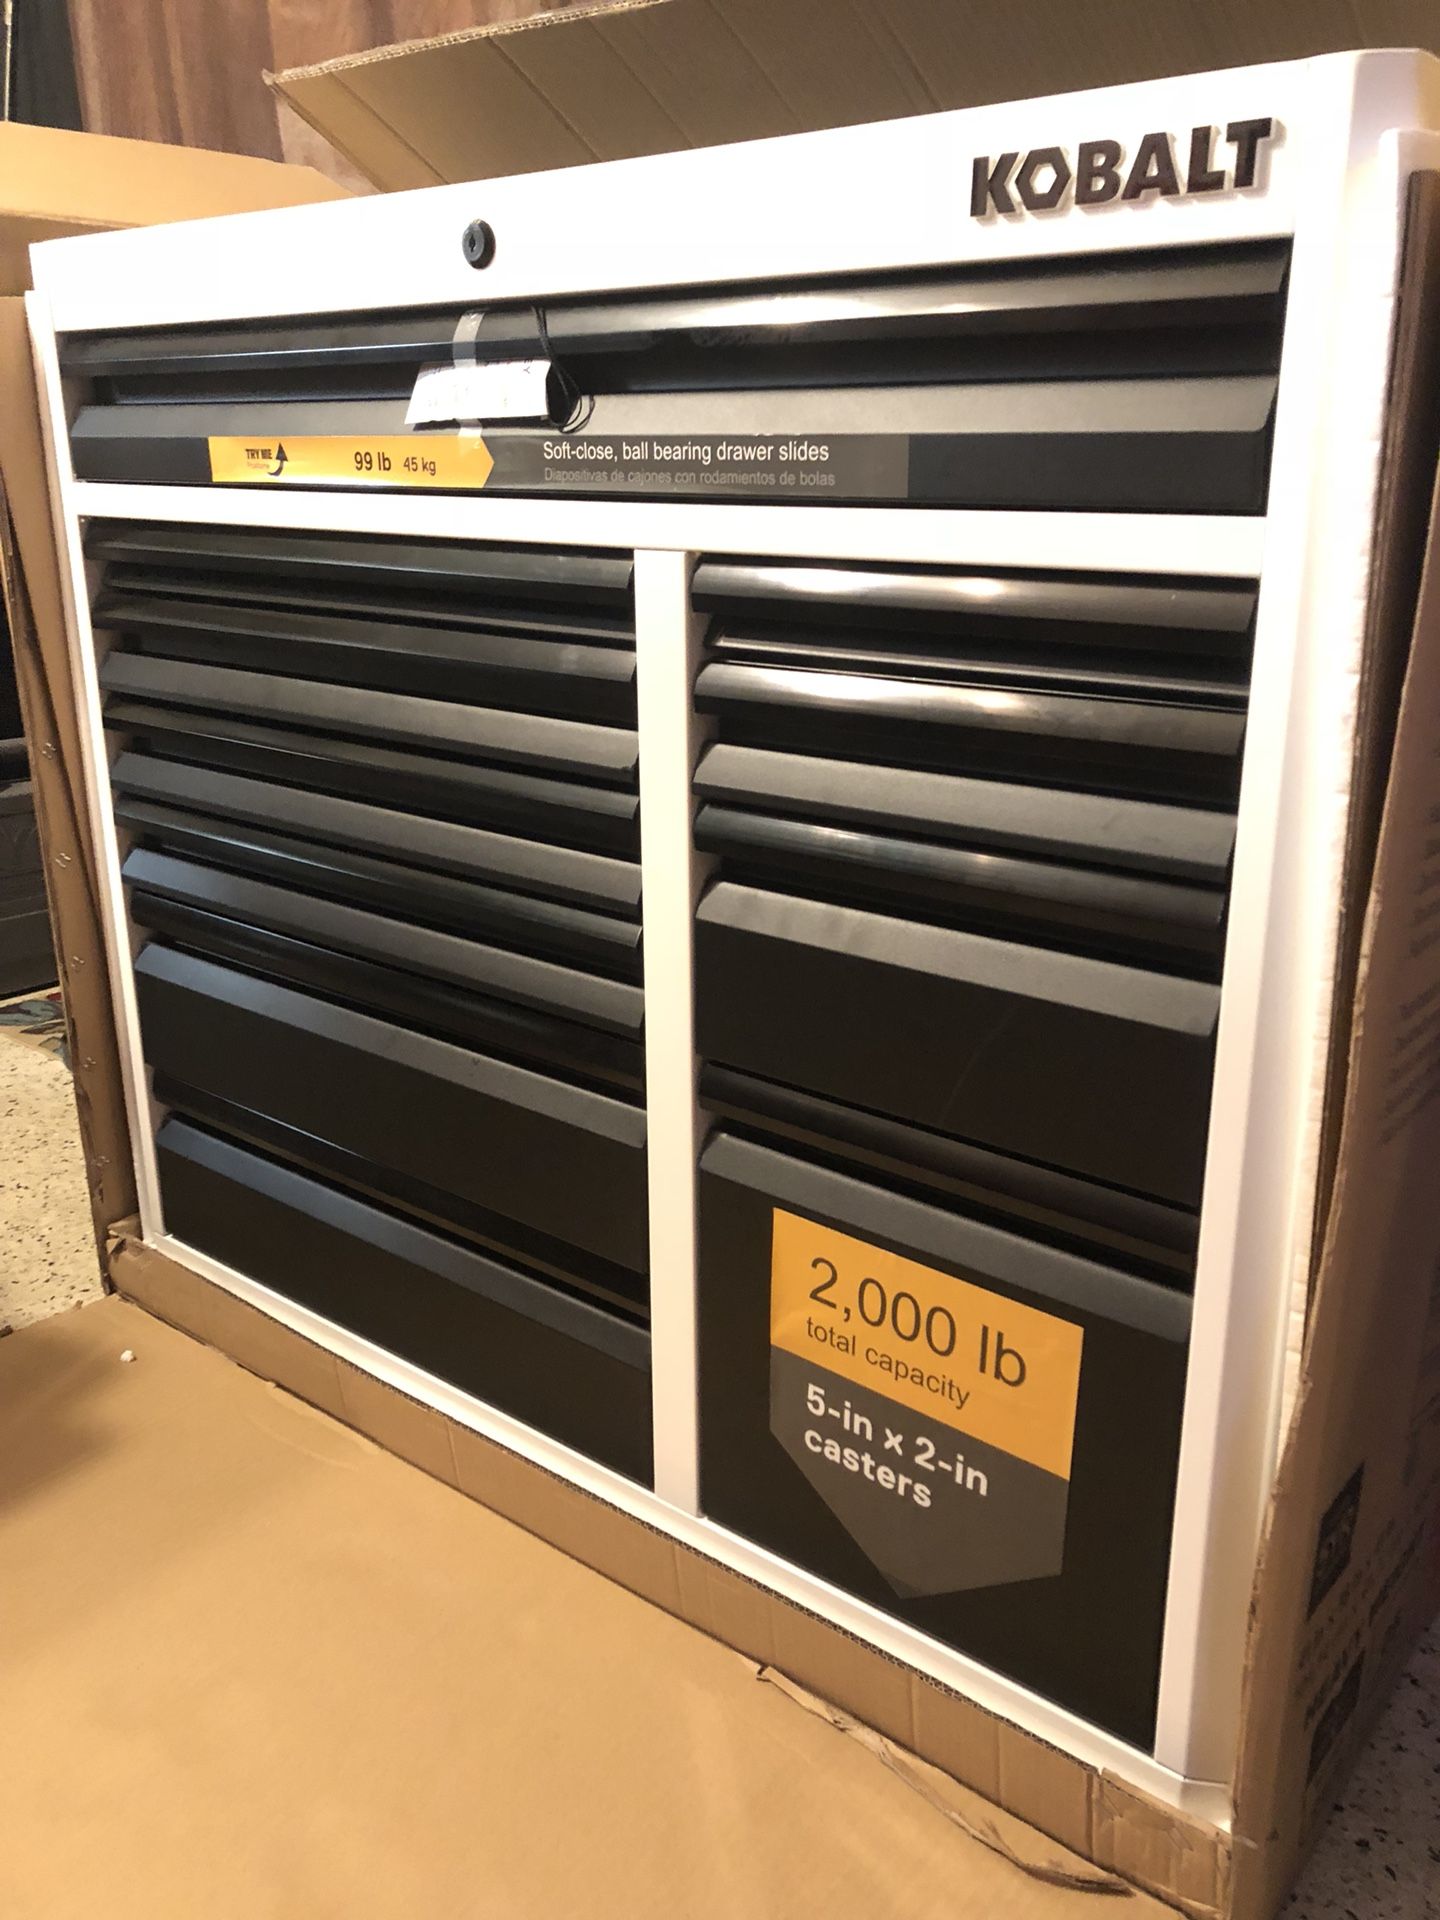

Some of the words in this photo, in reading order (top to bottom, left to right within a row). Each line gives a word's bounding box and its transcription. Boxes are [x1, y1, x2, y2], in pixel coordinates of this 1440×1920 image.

[970, 117, 1276, 219] KOBALT
[245, 448, 259, 460] TRY
[354, 451, 373, 471] 99
[377, 452, 392, 472] lb
[403, 457, 418, 472] 45
[421, 457, 437, 475] kg
[543, 441, 618, 462] Soft-close,
[622, 441, 649, 460] ball
[653, 442, 712, 465] bearing
[716, 441, 774, 461] drawer
[778, 441, 830, 462] slides
[610, 468, 625, 482] de
[627, 468, 672, 486] cajones
[674, 472, 697, 484] con
[700, 470, 776, 486] rodamientos
[779, 470, 796, 486] de
[800, 471, 836, 486] bolas
[808, 1256, 957, 1358] 2,000
[978, 1324, 1028, 1389] lb
[806, 1316, 857, 1357] total
[865, 1346, 970, 1410] capacity
[804, 1428, 932, 1508] casters
[806, 1382, 874, 1441] 5-in
[883, 1427, 903, 1456] x
[914, 1436, 989, 1498] 2-in
